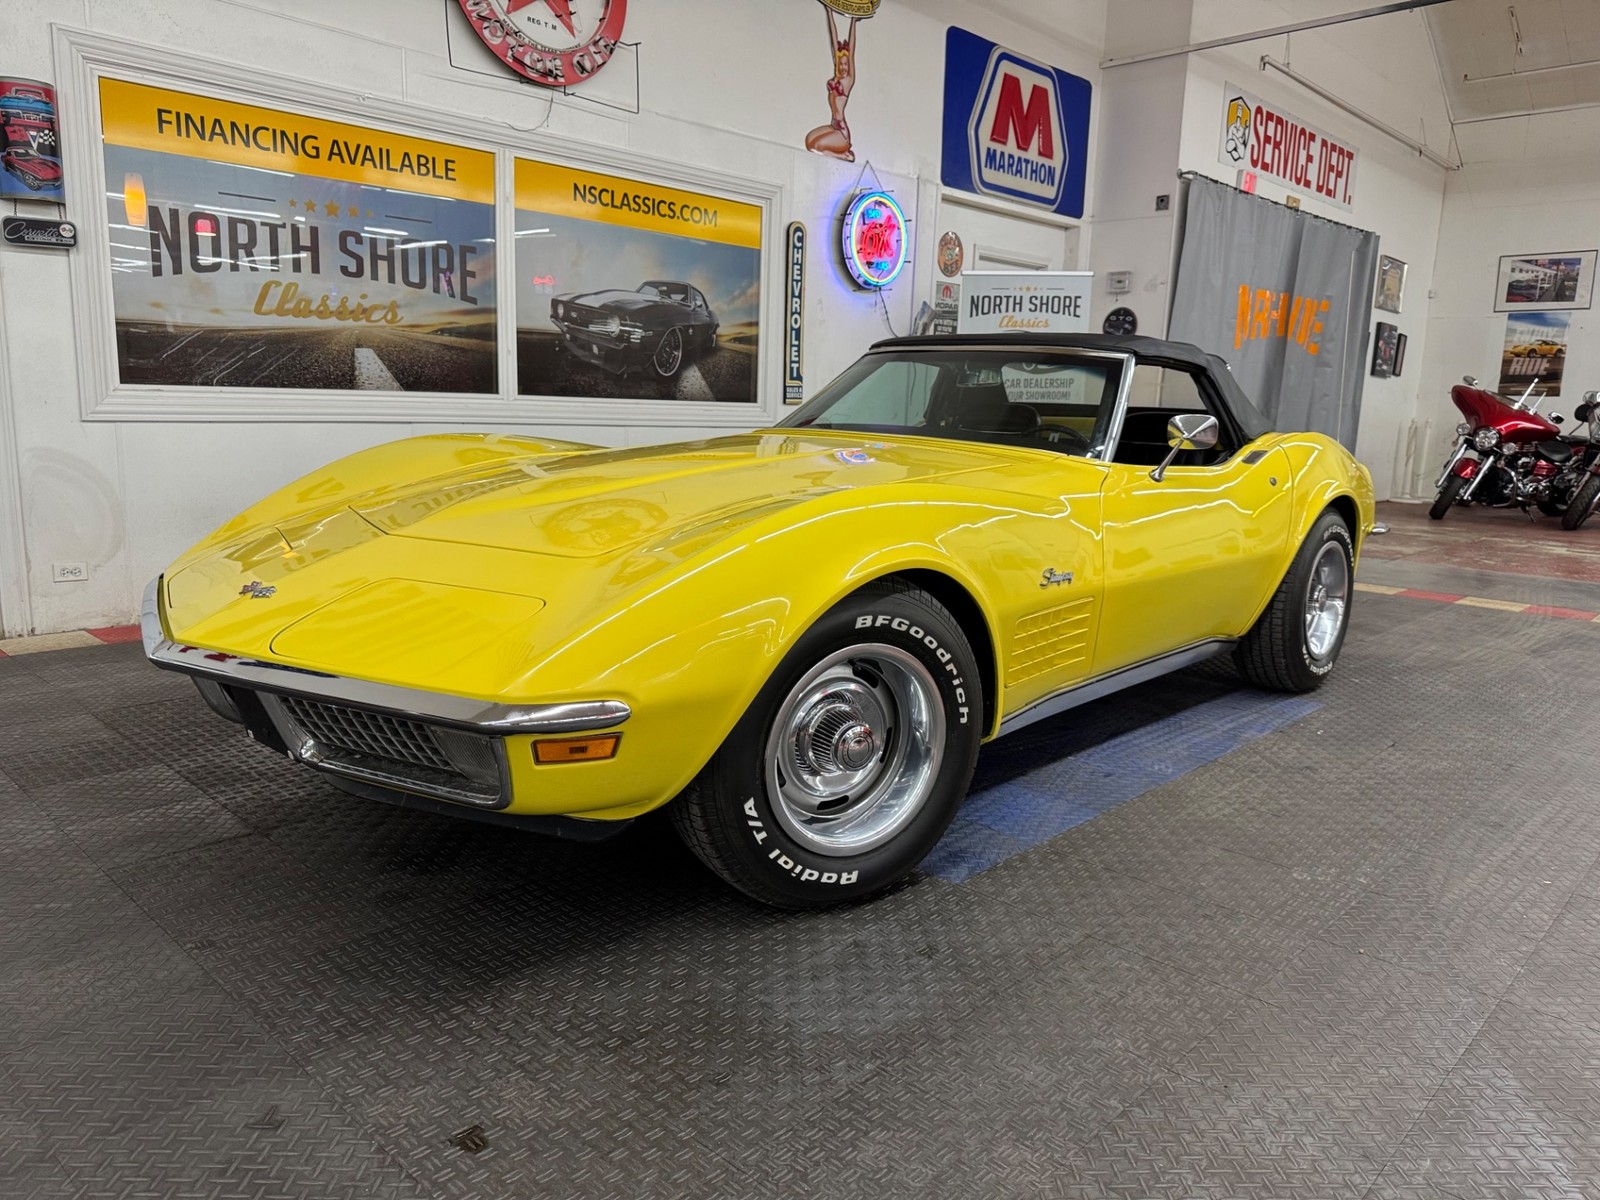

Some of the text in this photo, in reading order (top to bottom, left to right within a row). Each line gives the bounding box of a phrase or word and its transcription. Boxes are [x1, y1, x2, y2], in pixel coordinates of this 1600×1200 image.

[989, 71, 1054, 161] M
[156, 107, 457, 182] FINANCING AVAILABLE
[984, 146, 1056, 187] MARATHON
[1250, 105, 1355, 206] SERVICE DEPT.
[572, 182, 718, 228] NSCLASSICS.COM
[147, 204, 479, 306] NORTH SHORE
[253, 279, 404, 325] Classics
[791, 231, 803, 377] CHEVROLET
[969, 294, 1082, 318] NORTH SHORE
[998, 314, 1051, 329] Classics
[1004, 378, 1075, 389] CAR DEALERSHIP
[1508, 357, 1550, 376] RIDE
[1025, 390, 1071, 401] SHOWROOM!
[854, 614, 969, 724] BFGoodrich
[743, 796, 859, 885] Radial T/A
